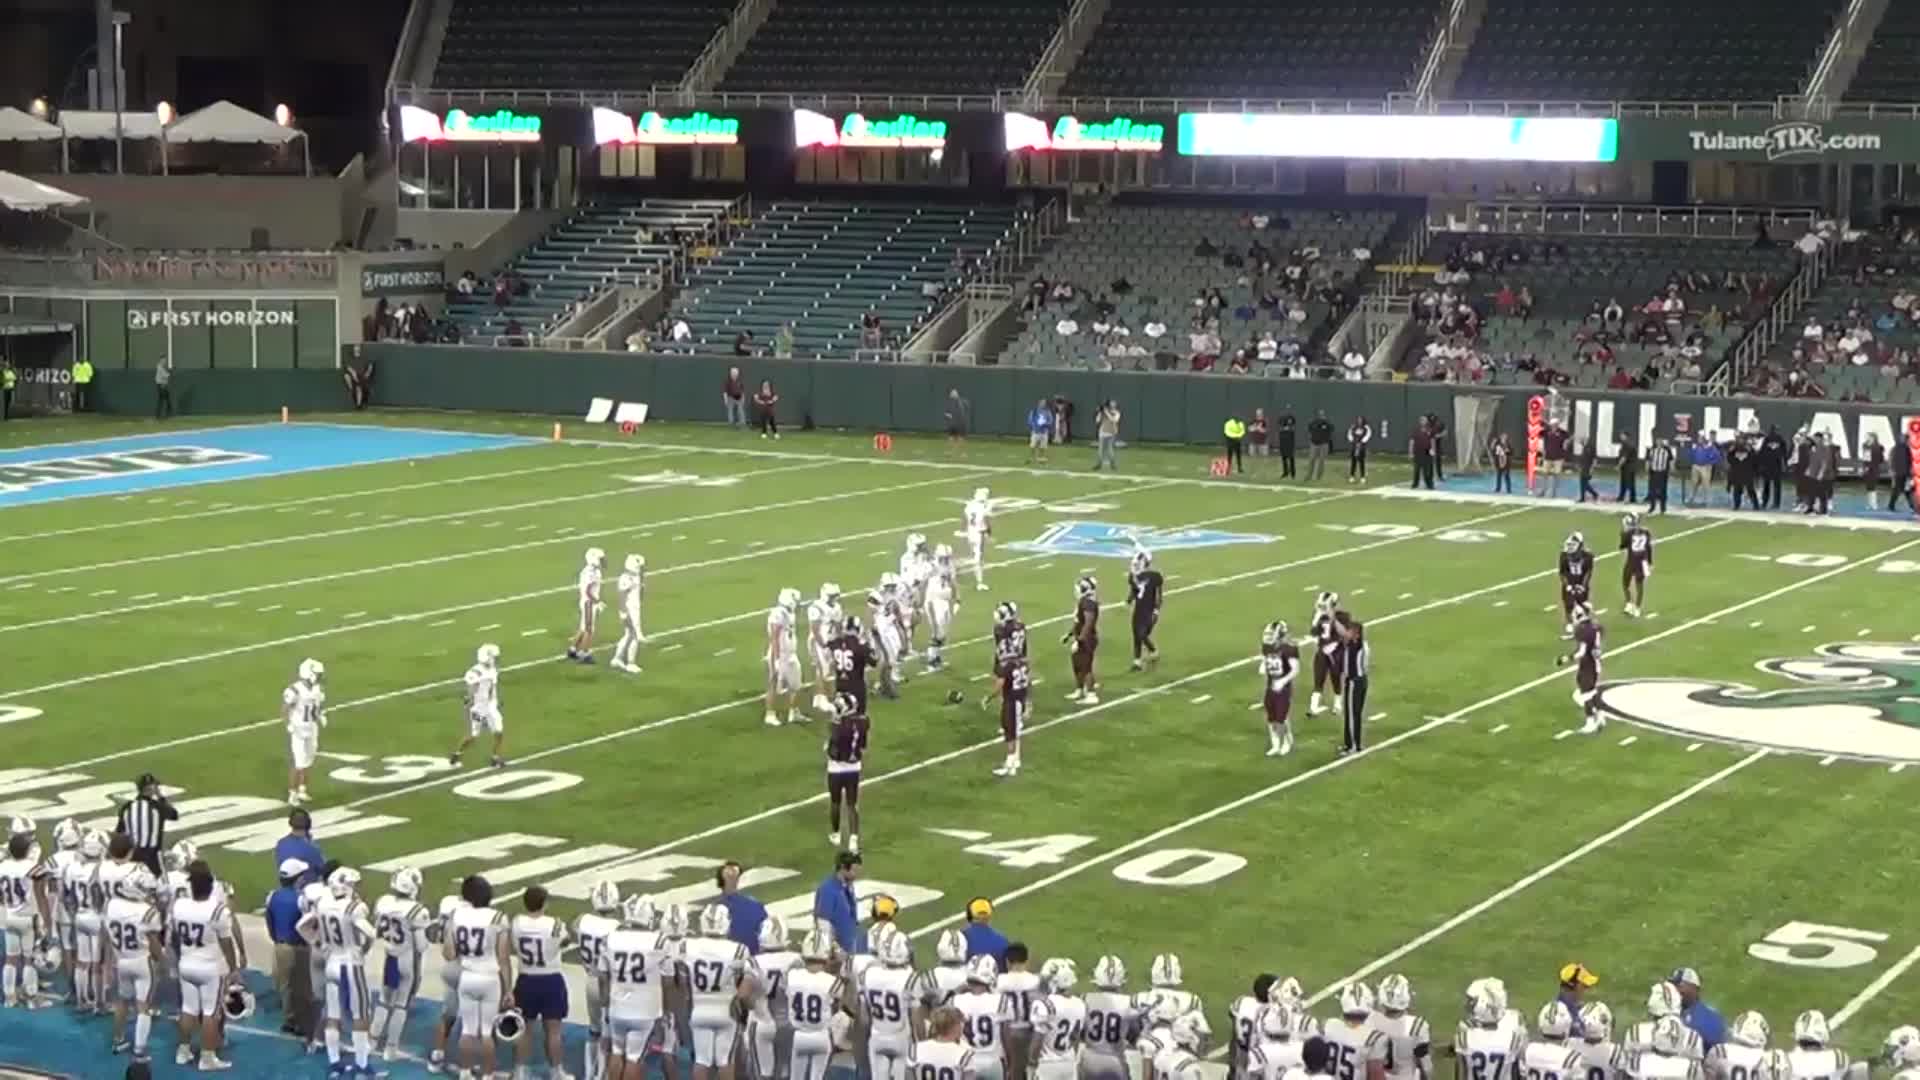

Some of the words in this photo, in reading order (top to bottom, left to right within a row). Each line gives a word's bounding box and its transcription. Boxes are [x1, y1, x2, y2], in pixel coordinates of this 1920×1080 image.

[151, 311, 202, 326] FIRST
[206, 311, 294, 326] HORIZON
[833, 648, 854, 672] 96
[109, 920, 138, 951] 32
[456, 926, 486, 957] 87
[518, 937, 546, 968] 51
[614, 952, 647, 983] 72
[694, 960, 724, 993] 67
[792, 991, 823, 1025] 48
[868, 989, 901, 1022] 59
[1088, 1010, 1122, 1044] 38
